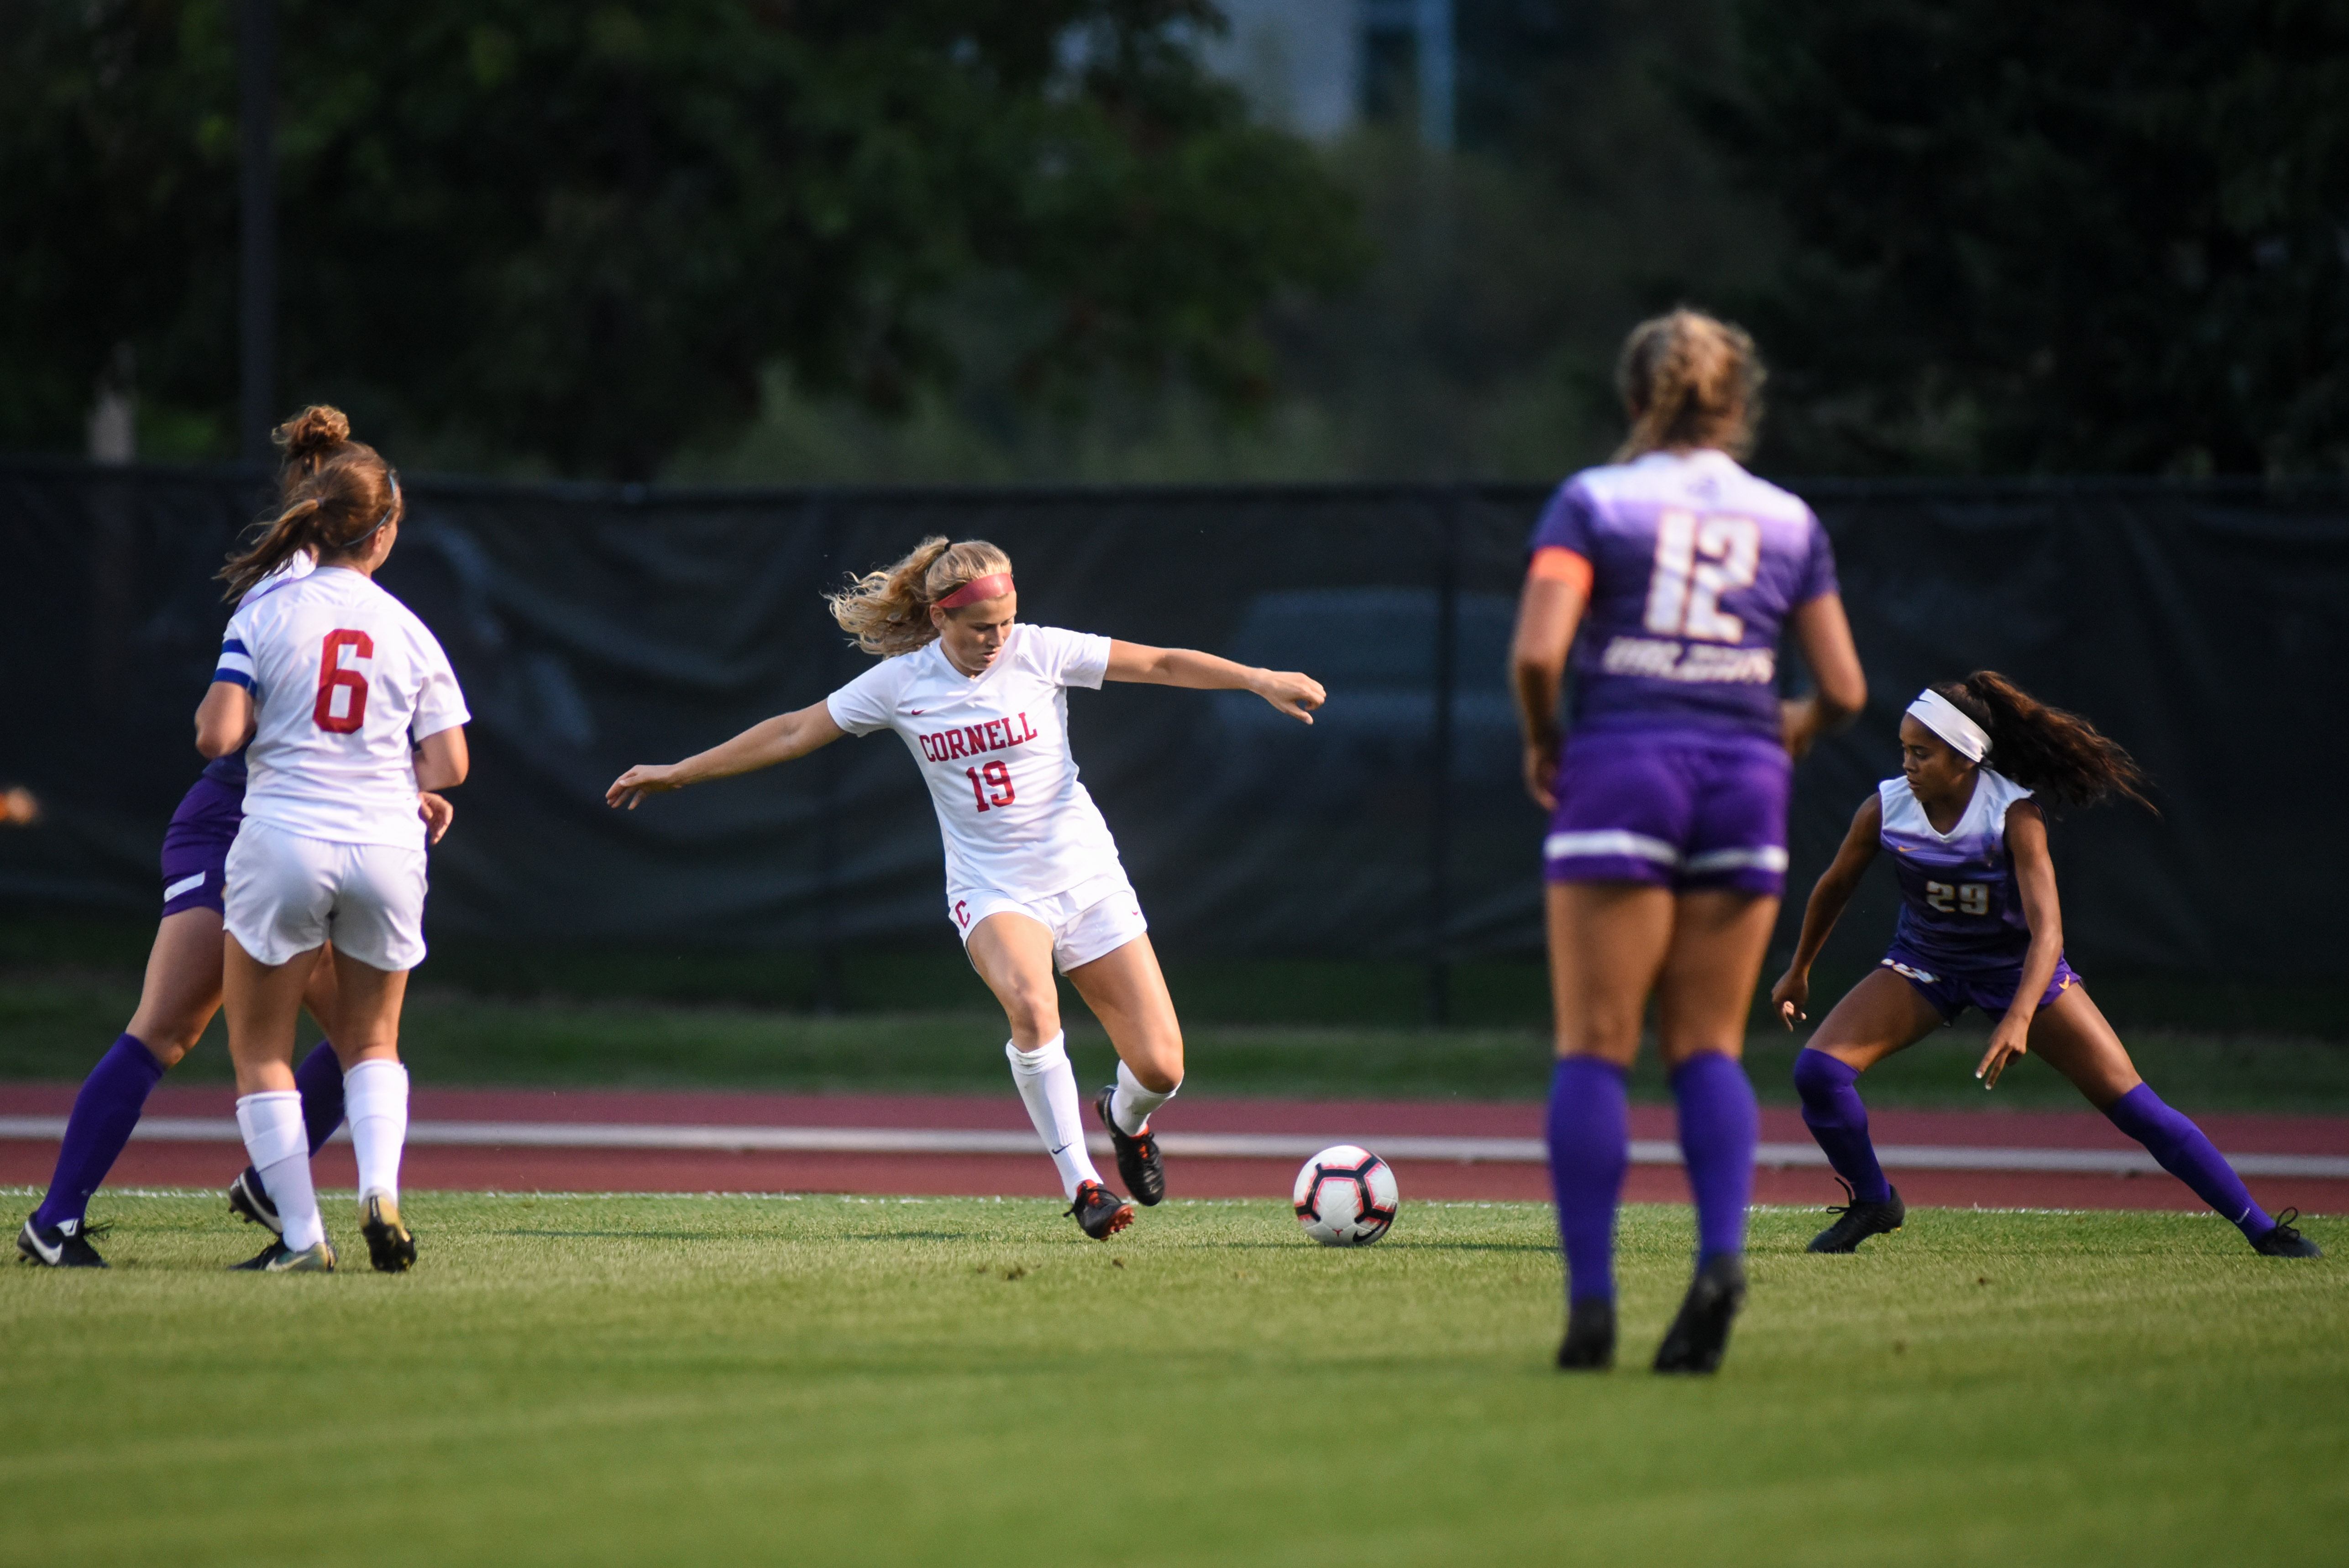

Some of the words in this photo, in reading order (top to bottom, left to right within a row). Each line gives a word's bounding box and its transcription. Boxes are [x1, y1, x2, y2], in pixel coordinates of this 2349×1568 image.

[1644, 508, 1761, 644] 12
[313, 629, 373, 734] 6
[919, 712, 1038, 762] CORNELL
[965, 760, 1016, 813] 19
[955, 899, 971, 929] C
[1925, 880, 1989, 915] 29
